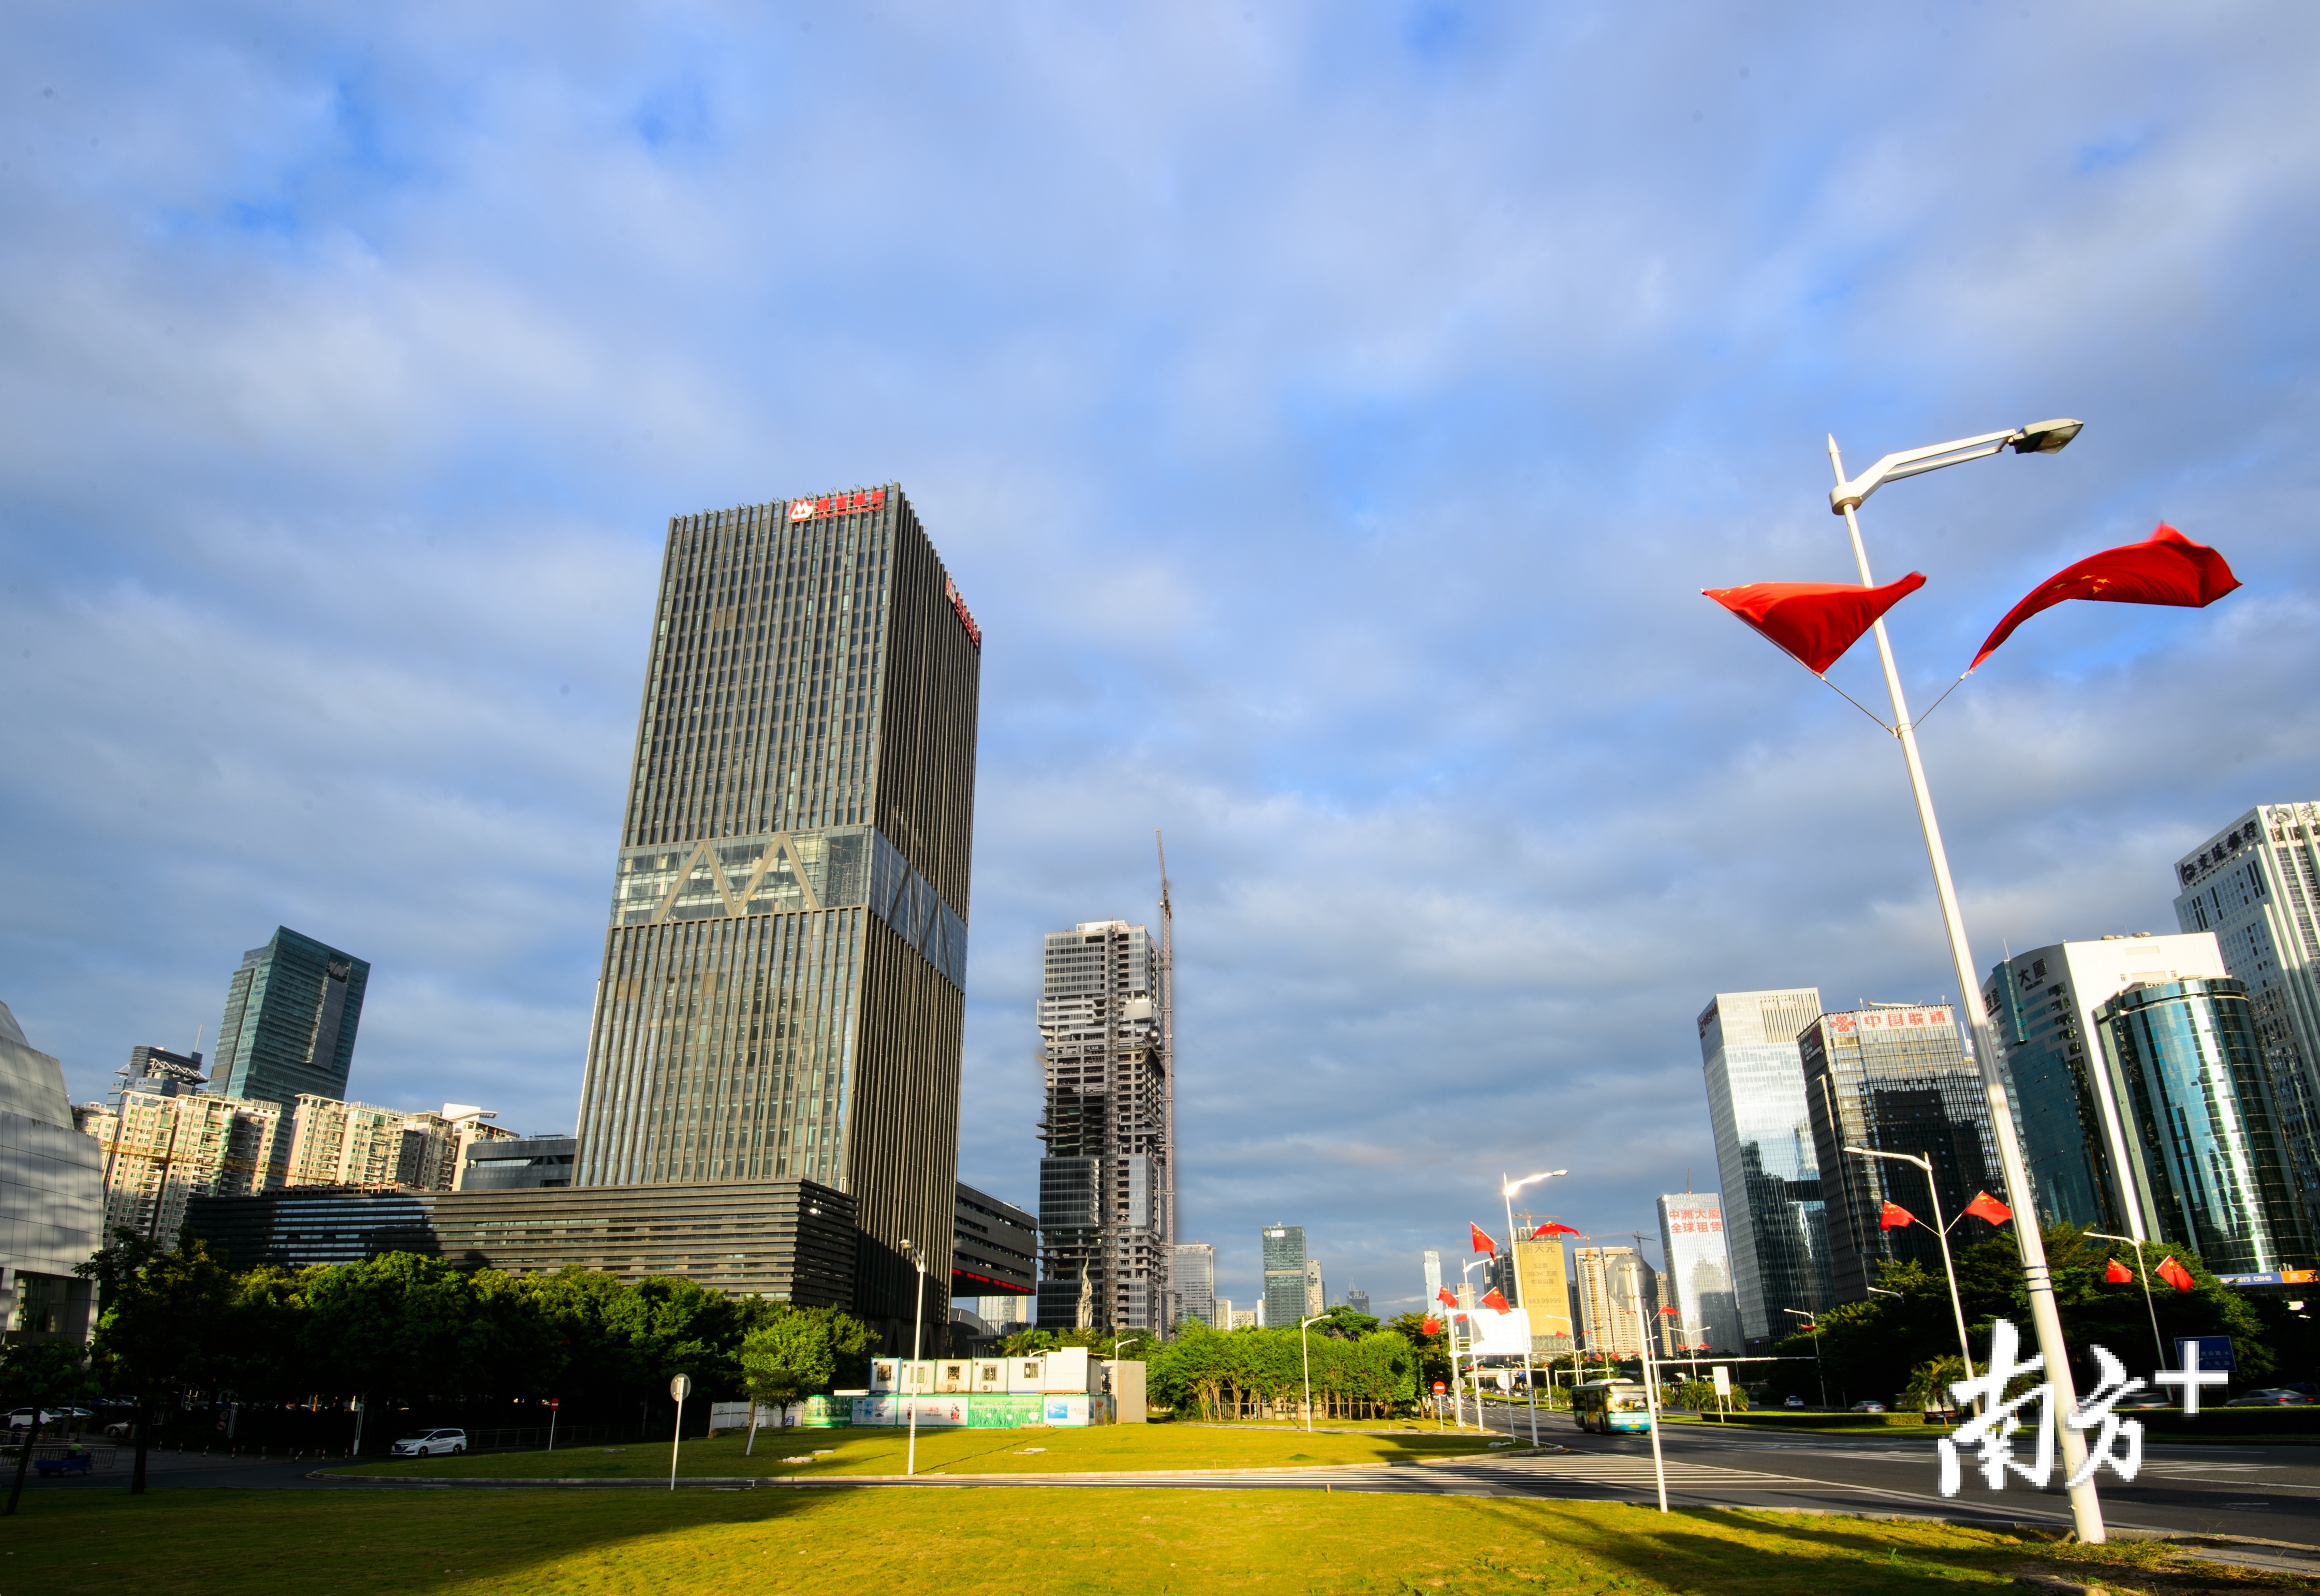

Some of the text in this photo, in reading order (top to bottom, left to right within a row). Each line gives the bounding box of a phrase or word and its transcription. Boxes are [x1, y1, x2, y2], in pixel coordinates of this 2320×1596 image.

[1864, 1010, 1946, 1028] 中国联通
[1669, 1208, 1721, 1220] 中洲大厦
[1671, 1221, 1723, 1233] 全球租赁
[1534, 1244, 1556, 1253] 天元
